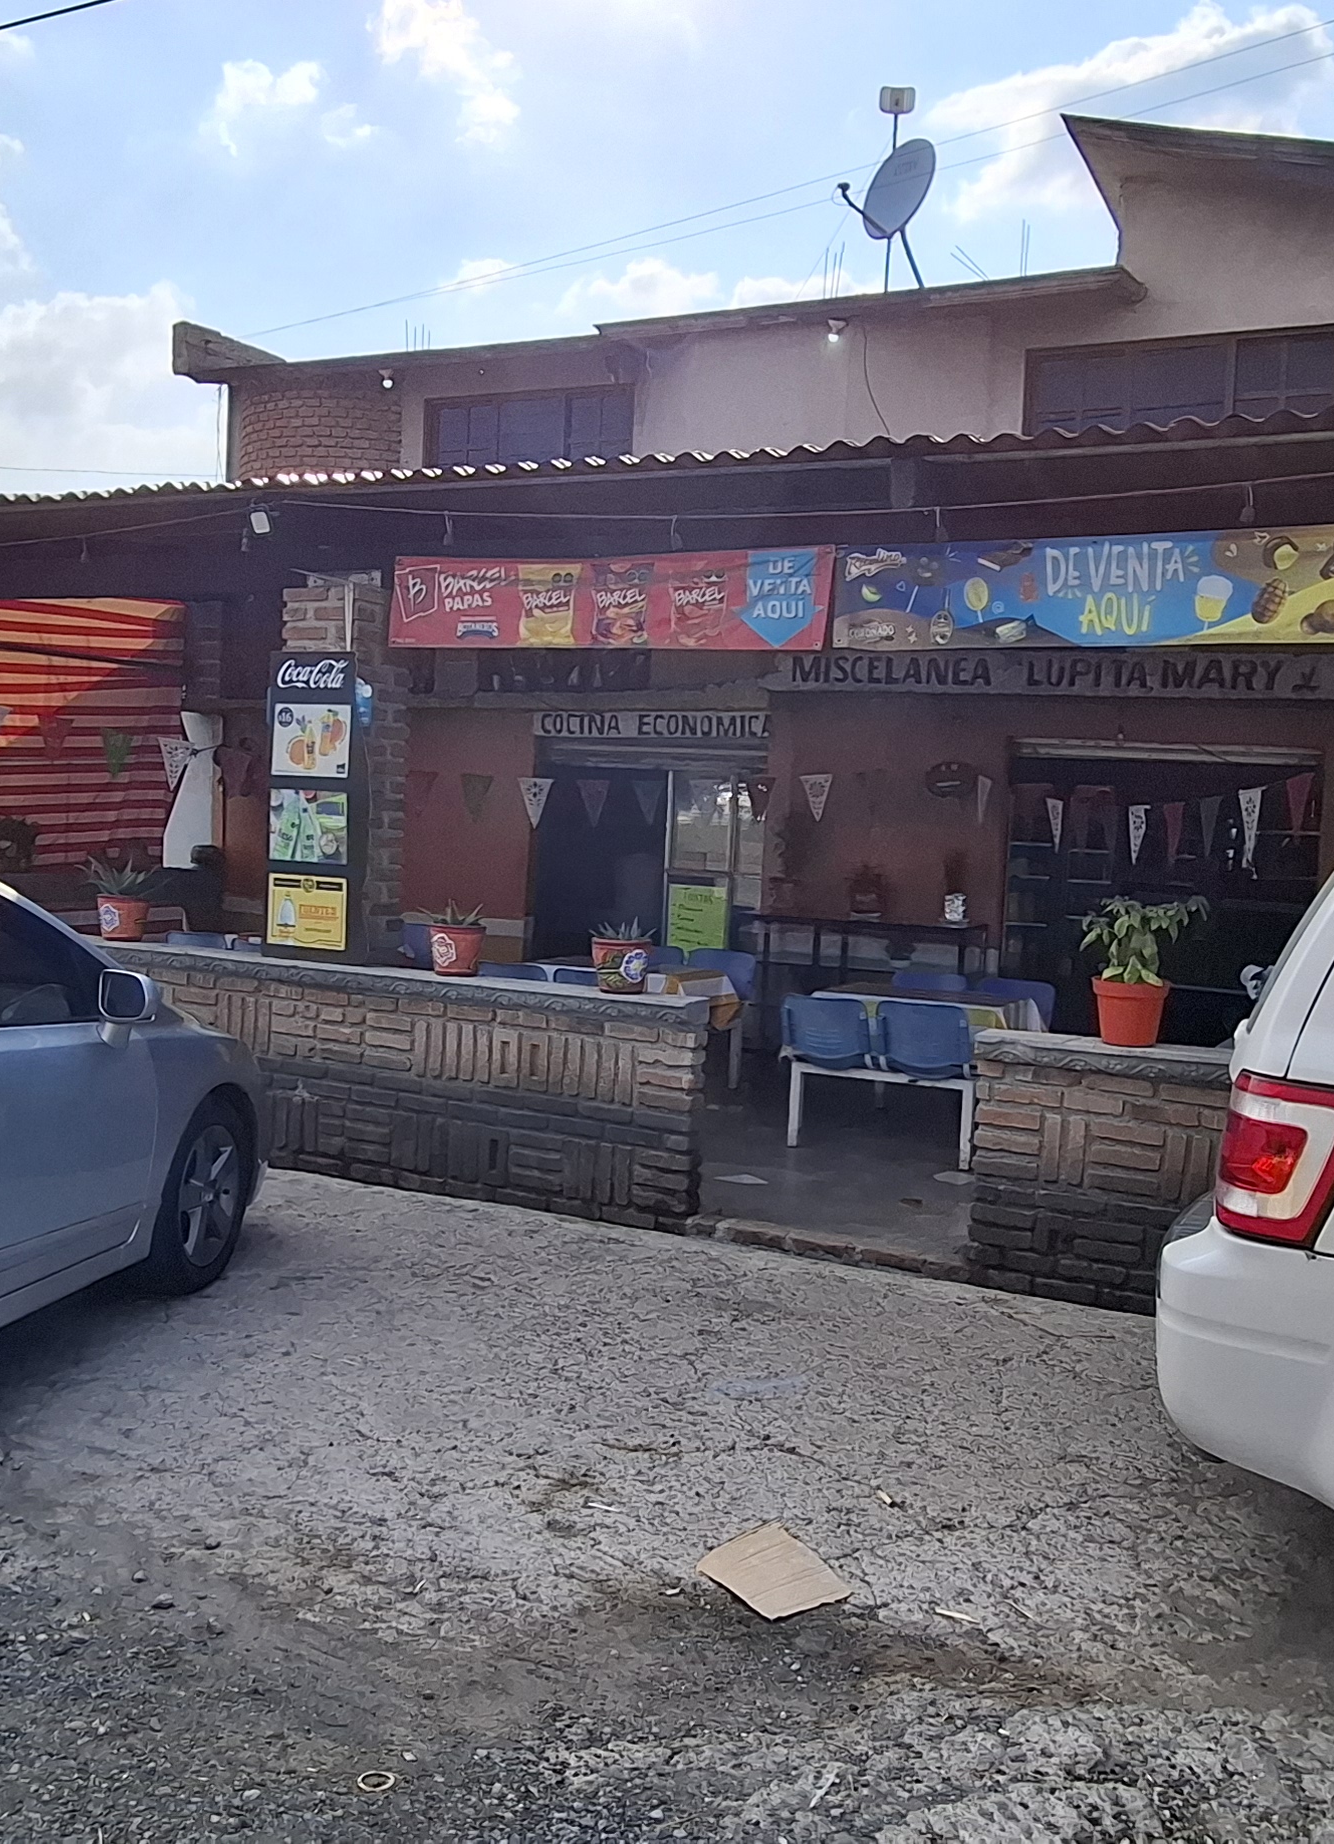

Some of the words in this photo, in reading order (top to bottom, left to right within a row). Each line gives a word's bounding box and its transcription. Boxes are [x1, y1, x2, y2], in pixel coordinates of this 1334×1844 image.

[768, 557, 796, 574] DE
[1046, 546, 1081, 597] DE
[1087, 541, 1185, 593] VENTA
[675, 587, 725, 606] BARCEL
[748, 577, 812, 597] VENTA
[444, 592, 493, 612] PAPAS
[523, 589, 571, 610] BARCEL
[596, 588, 647, 608] BARCEL
[1078, 592, 1156, 636] AQUÍ
[276, 659, 349, 689] Coca-Cola
[791, 656, 992, 687] MISCELANEA
[1161, 659, 1284, 691] MARY
[540, 713, 621, 735] COCINA
